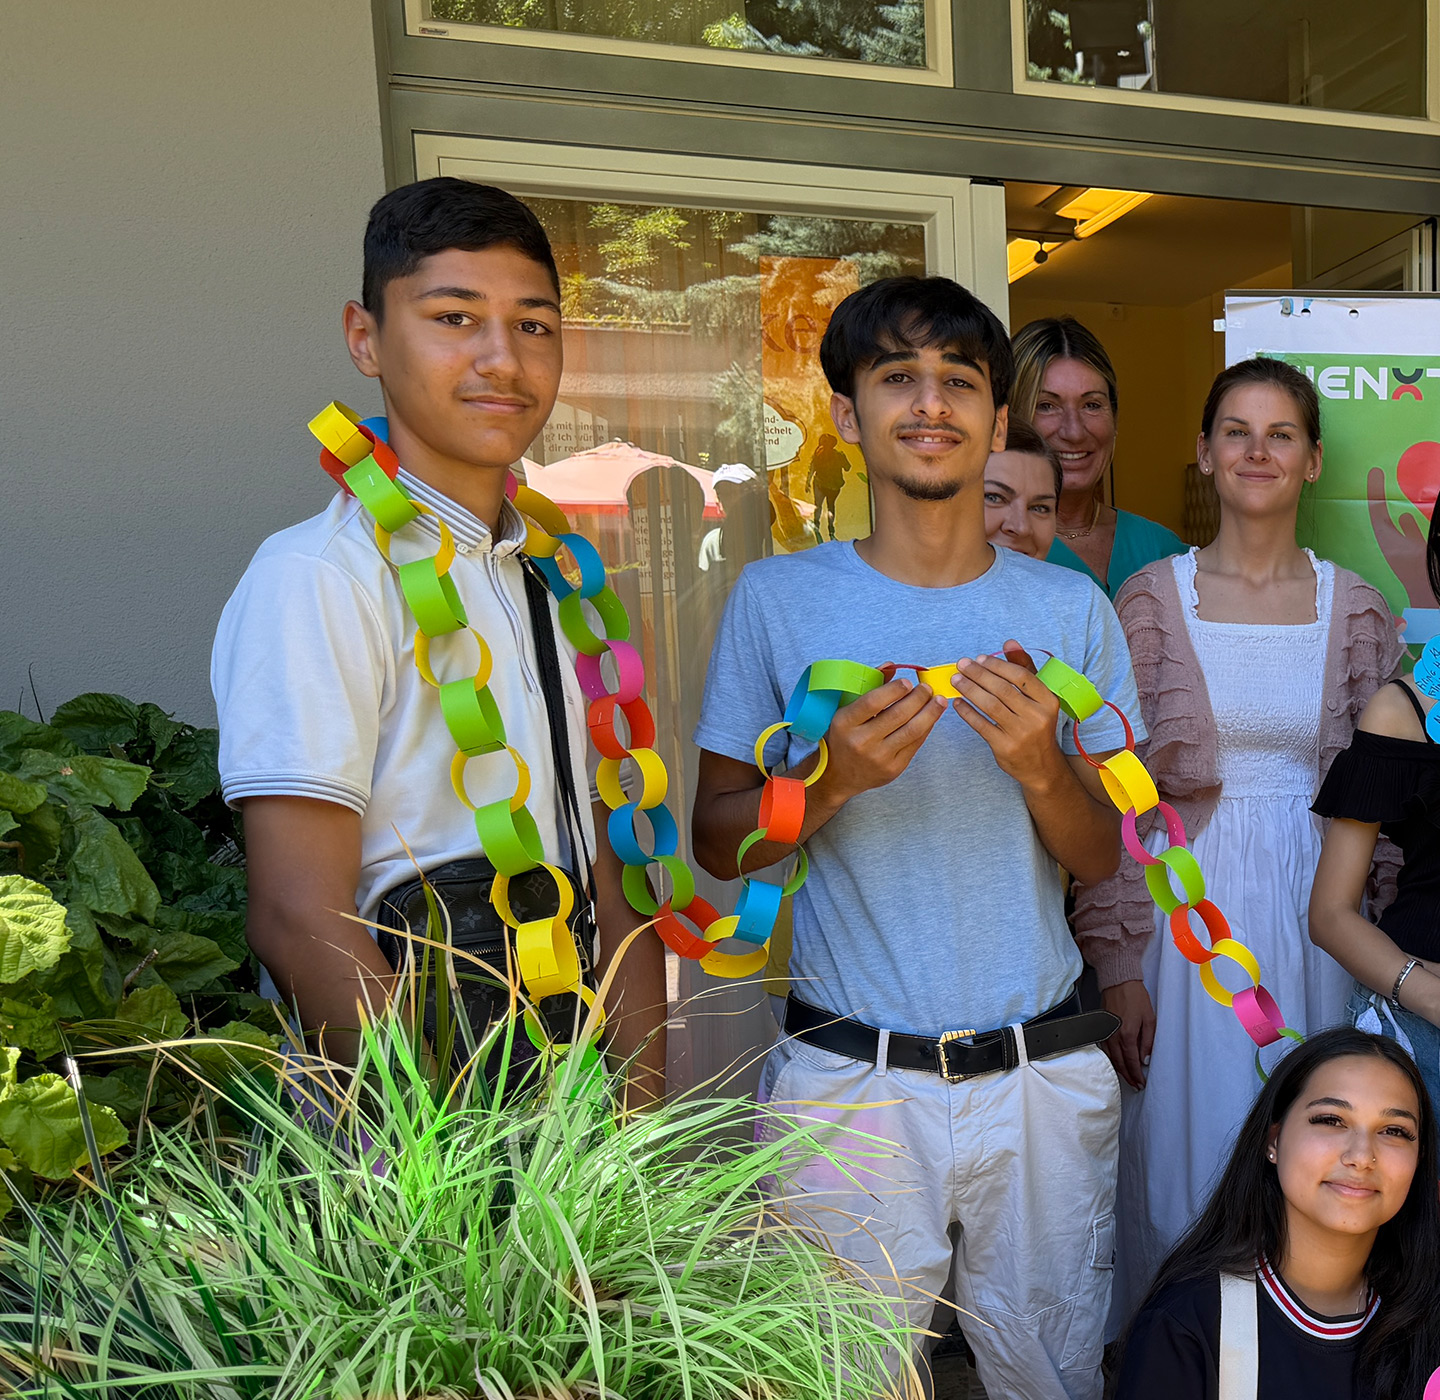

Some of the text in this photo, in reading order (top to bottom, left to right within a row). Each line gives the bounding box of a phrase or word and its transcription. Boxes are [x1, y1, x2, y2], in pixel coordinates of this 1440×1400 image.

[556, 421, 573, 431] mit
[558, 433, 572, 441] Ich
[575, 434, 604, 442] würe
